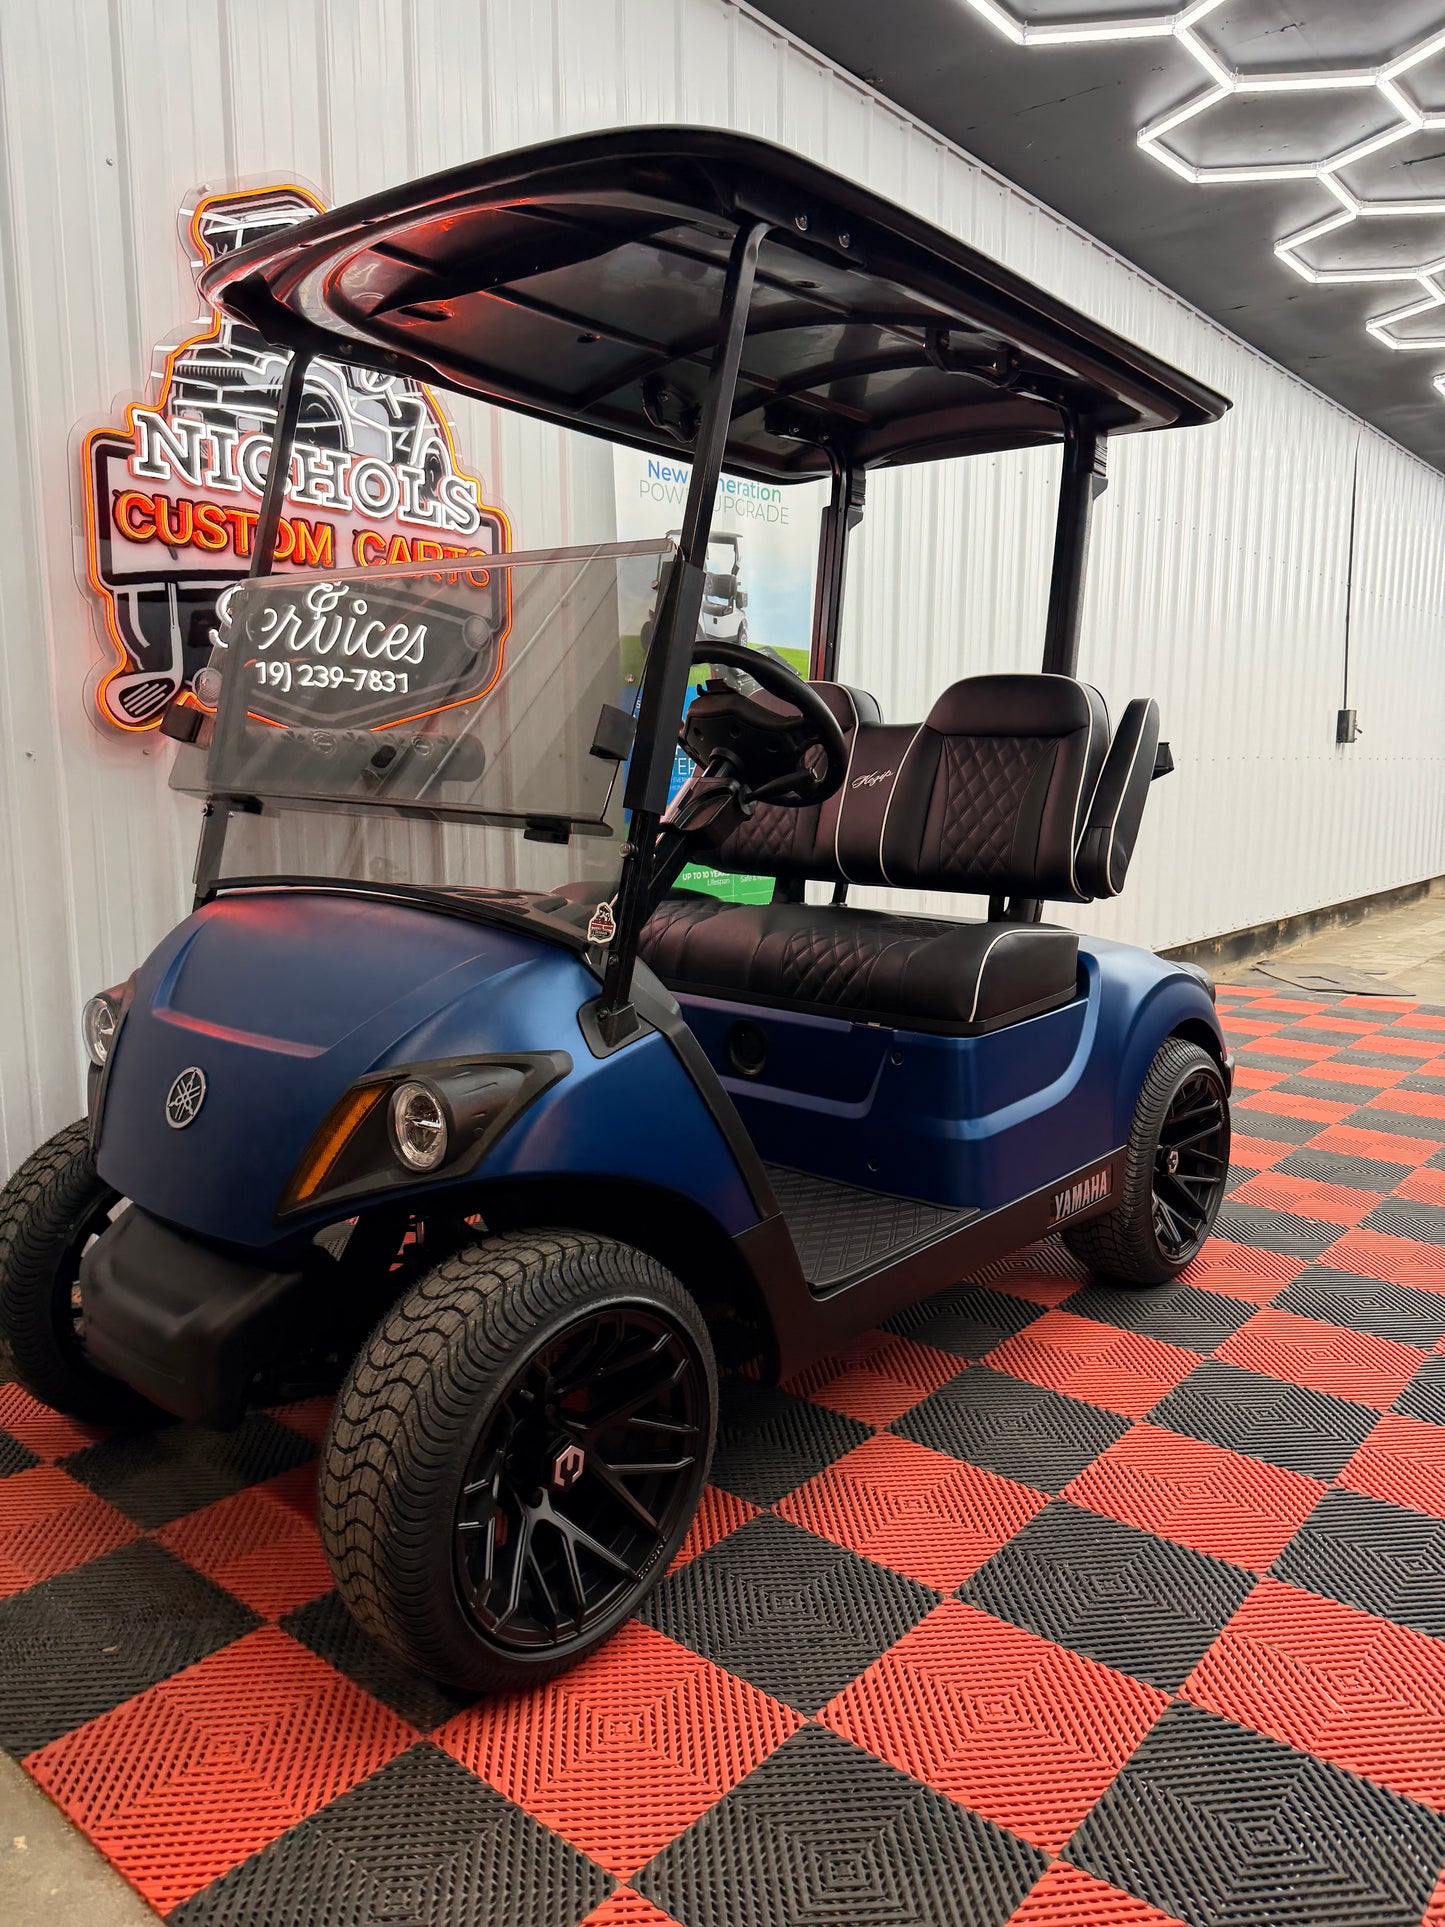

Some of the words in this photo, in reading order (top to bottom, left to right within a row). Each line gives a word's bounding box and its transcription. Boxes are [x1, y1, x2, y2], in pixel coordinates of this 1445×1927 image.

[131, 409, 481, 535] NICHOLS
[648, 459, 689, 484] New
[718, 477, 782, 503] neration
[639, 479, 689, 505] POW
[306, 581, 350, 620] &
[255, 660, 292, 692] 19)
[296, 664, 409, 694] 239-7831
[682, 872, 692, 881] UP
[692, 871, 702, 880] TO
[1054, 1170, 1107, 1221] YAMAHA
